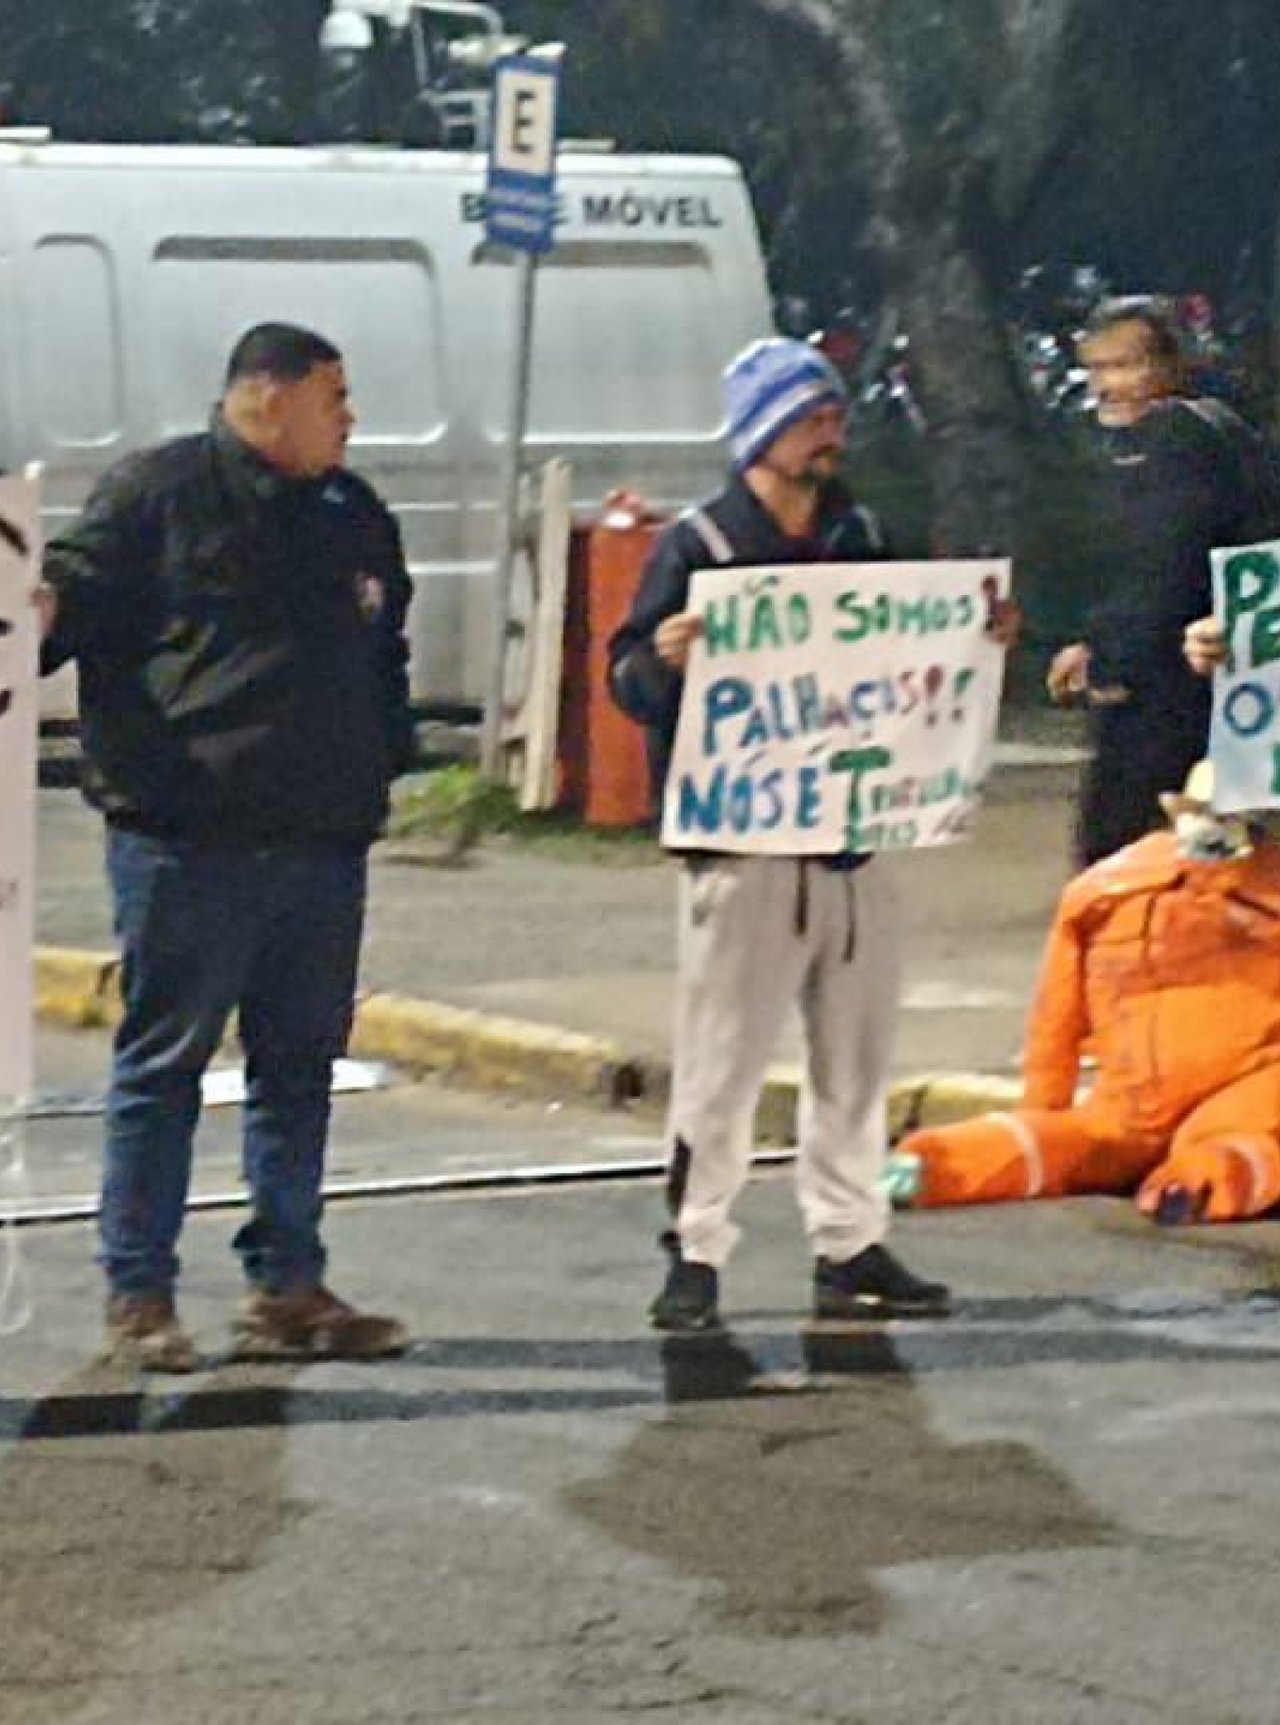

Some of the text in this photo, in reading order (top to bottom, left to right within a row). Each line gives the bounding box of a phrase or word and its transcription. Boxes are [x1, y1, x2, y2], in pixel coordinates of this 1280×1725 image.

[513, 90, 536, 153] E
[583, 189, 722, 228] MÓVEL
[704, 575, 811, 656] NÃO
[677, 751, 784, 834] NÓS
